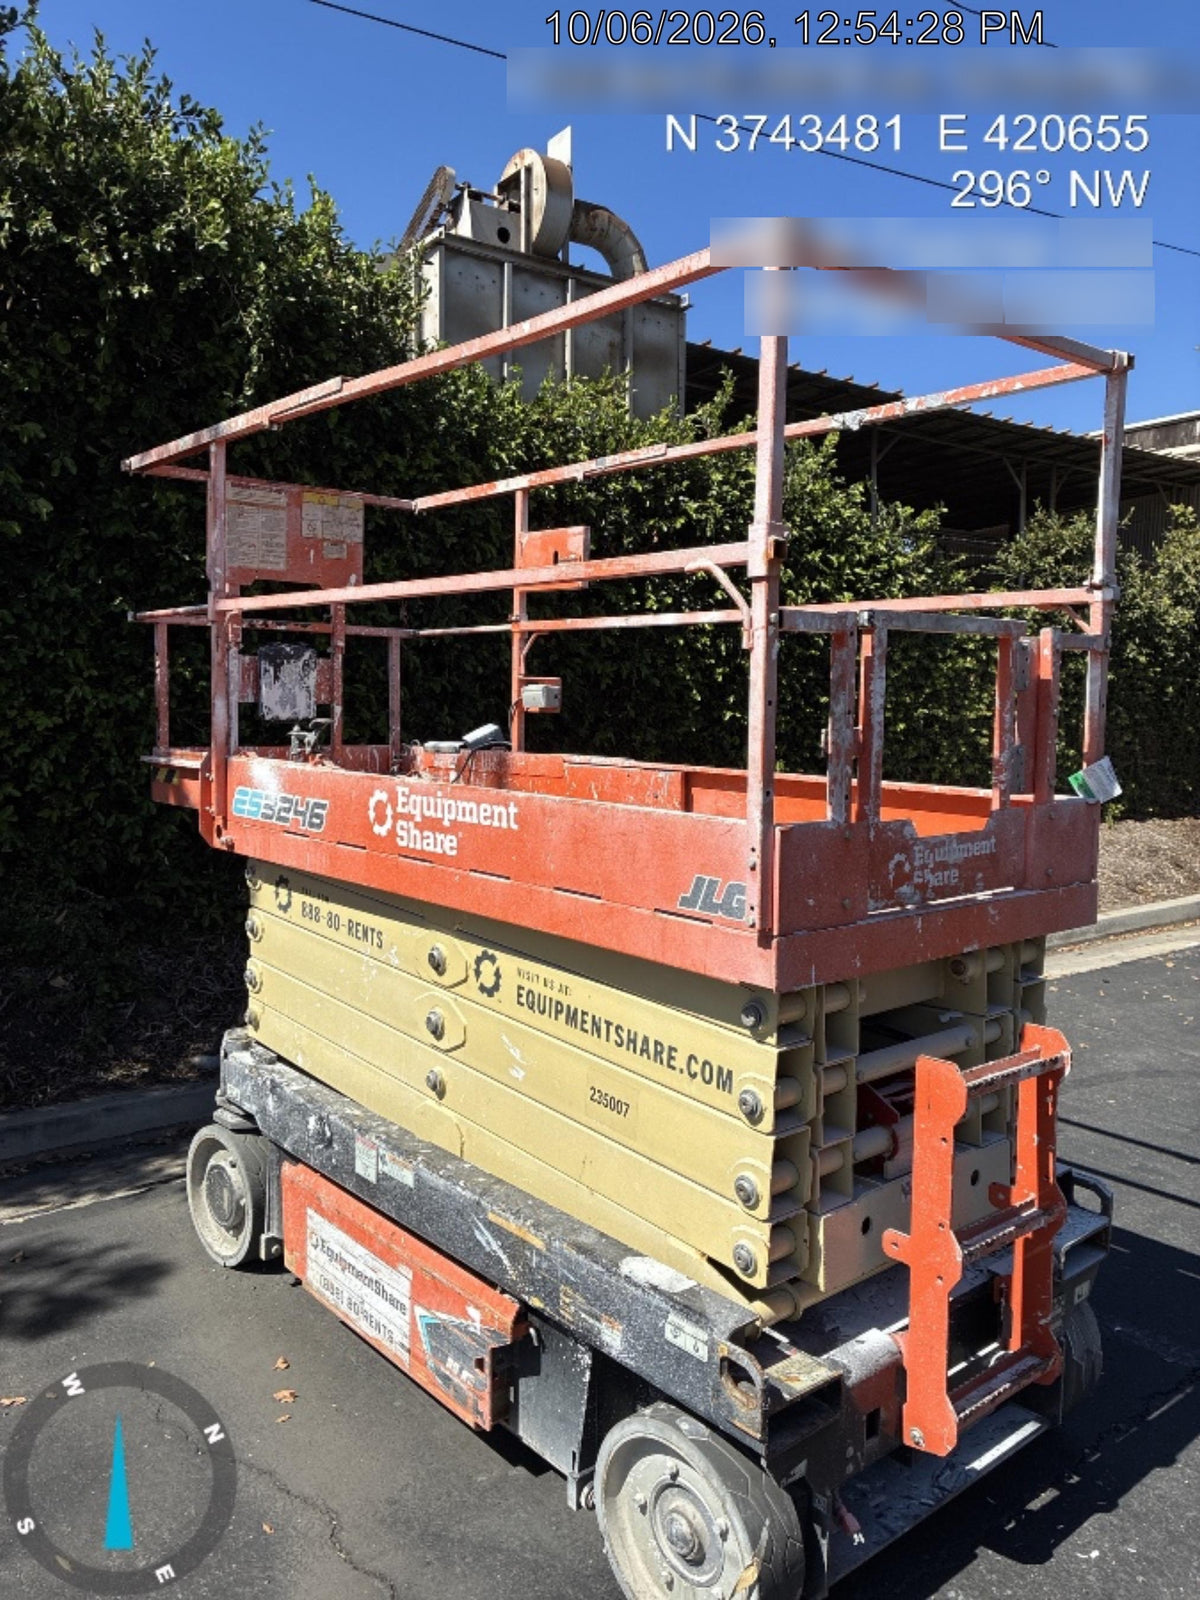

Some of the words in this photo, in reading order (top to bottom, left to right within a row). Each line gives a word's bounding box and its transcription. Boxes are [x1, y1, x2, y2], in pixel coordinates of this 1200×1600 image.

[233, 786, 329, 832] ES3246
[396, 785, 519, 830] Equipment
[395, 820, 458, 856] Share
[677, 874, 747, 921] JLG
[516, 984, 734, 1094] EQUIPMENTSHARE.COM
[589, 1085, 630, 1117] 235007
